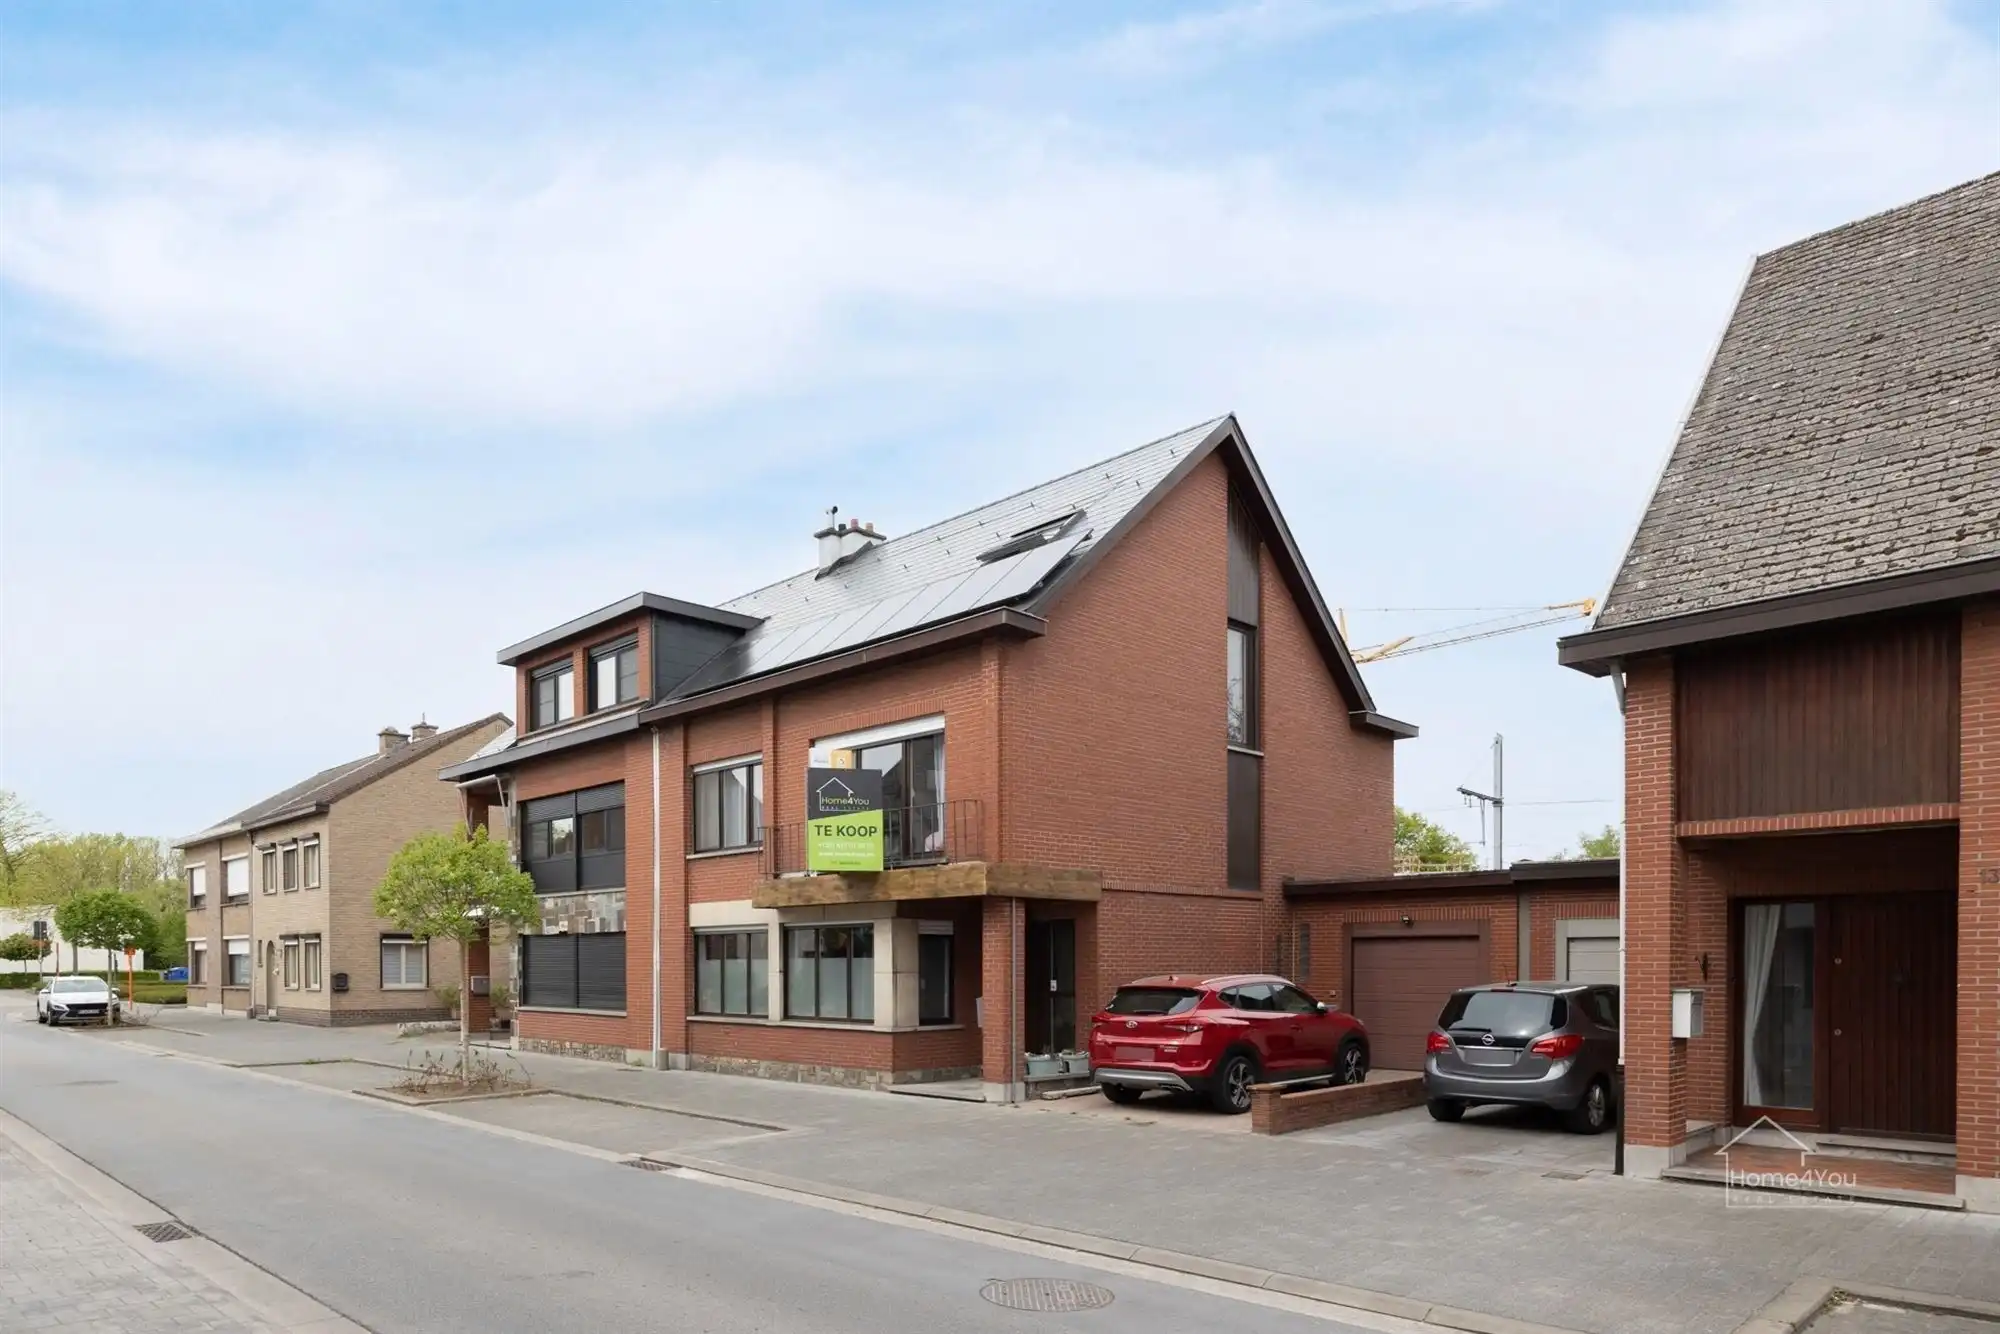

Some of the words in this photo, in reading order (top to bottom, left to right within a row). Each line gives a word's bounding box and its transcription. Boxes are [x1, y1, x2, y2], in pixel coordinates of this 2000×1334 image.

[821, 796, 870, 806] Home4You
[814, 825, 832, 836] TE
[836, 825, 877, 837] KOOP
